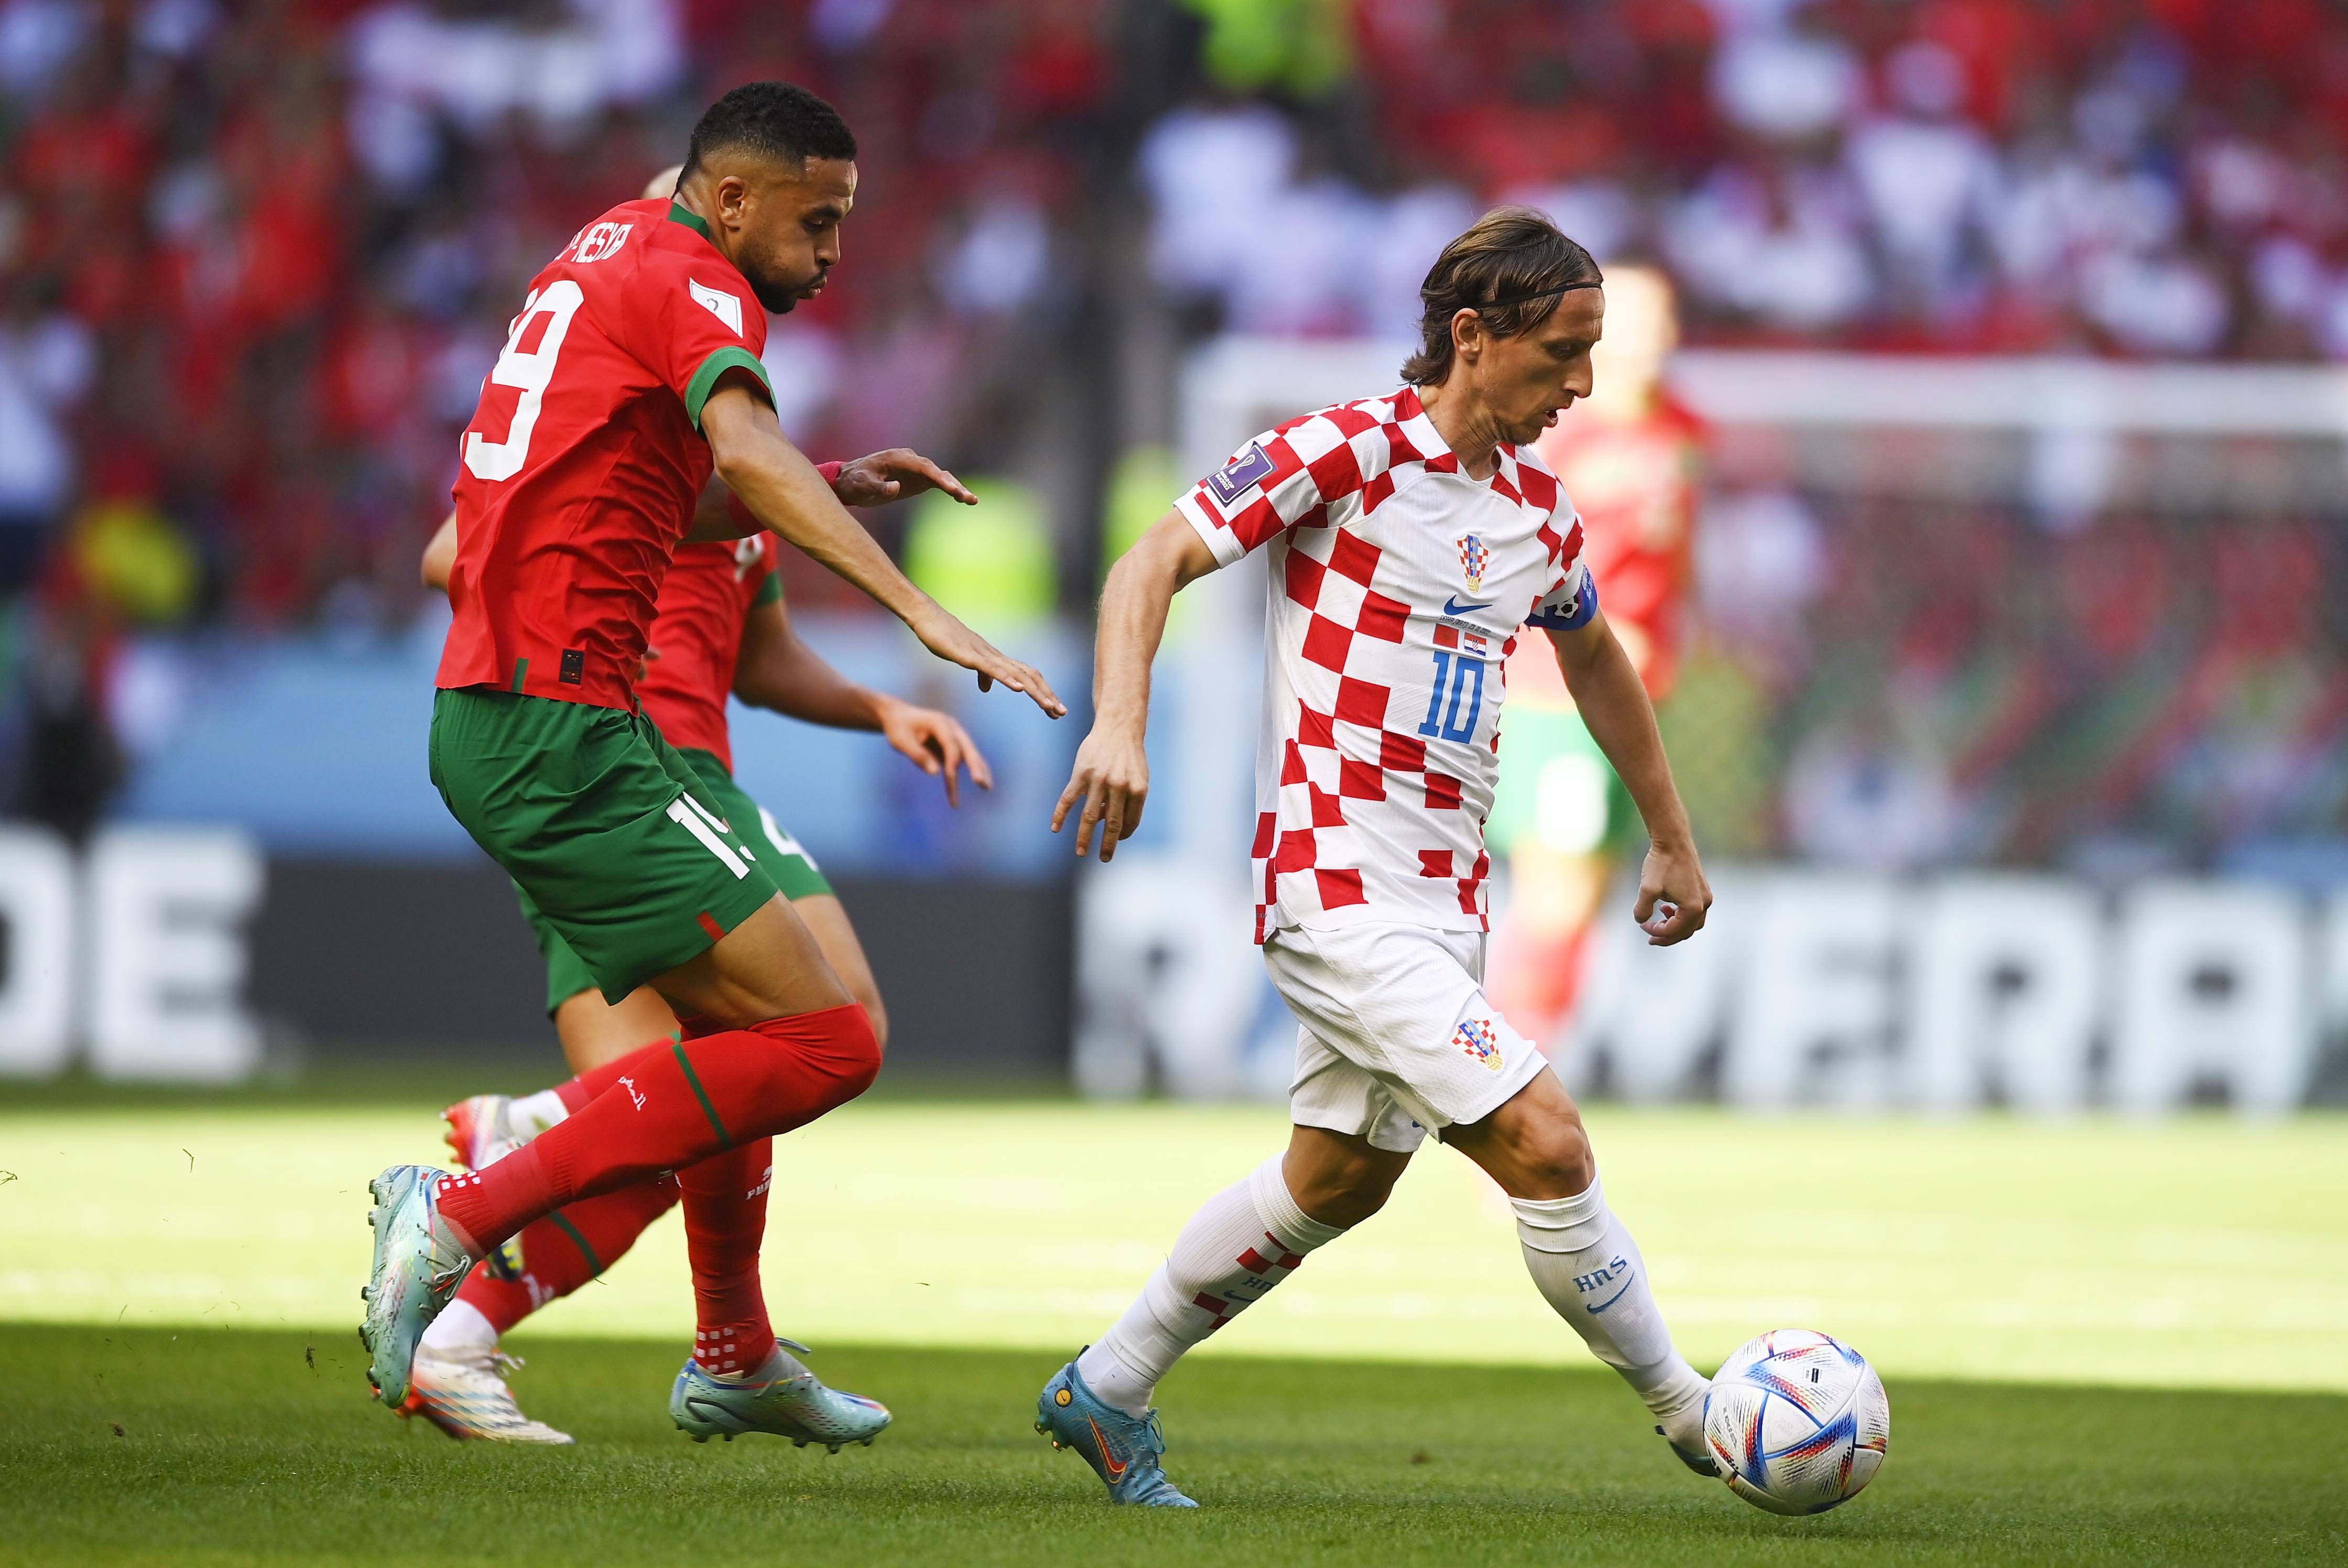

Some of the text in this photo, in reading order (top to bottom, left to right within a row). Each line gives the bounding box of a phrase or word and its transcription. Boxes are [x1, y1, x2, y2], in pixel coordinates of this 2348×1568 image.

[460, 280, 584, 482] 9
[1418, 650, 1484, 744] 10
[1241, 1277, 1278, 1292] HN
[1572, 1255, 1627, 1293] HNS
